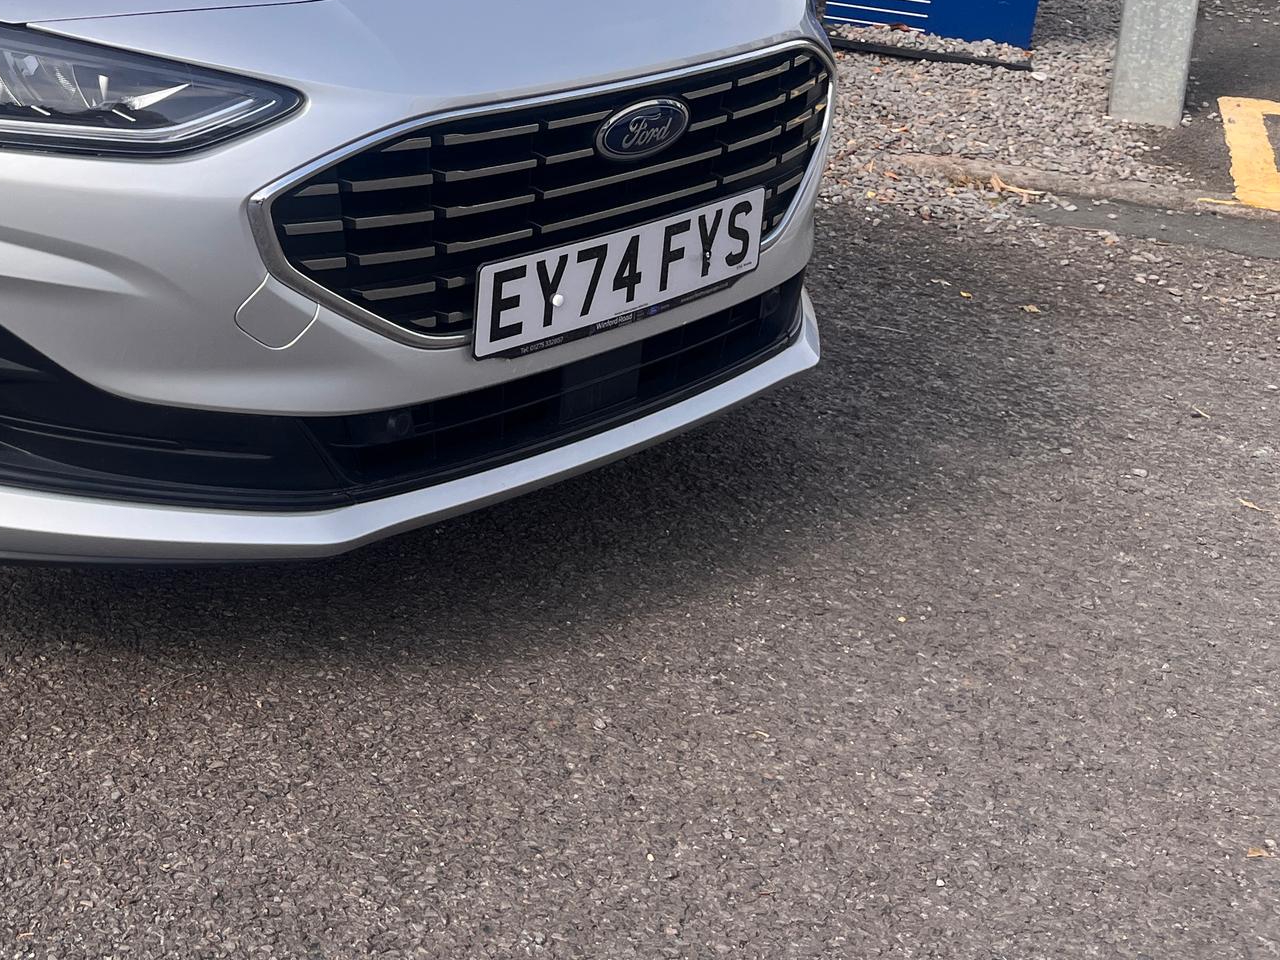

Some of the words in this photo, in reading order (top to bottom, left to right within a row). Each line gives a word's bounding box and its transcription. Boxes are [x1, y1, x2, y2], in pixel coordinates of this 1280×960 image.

[621, 112, 673, 149] Ford
[489, 234, 642, 343] EY74
[659, 200, 753, 292] FYS
